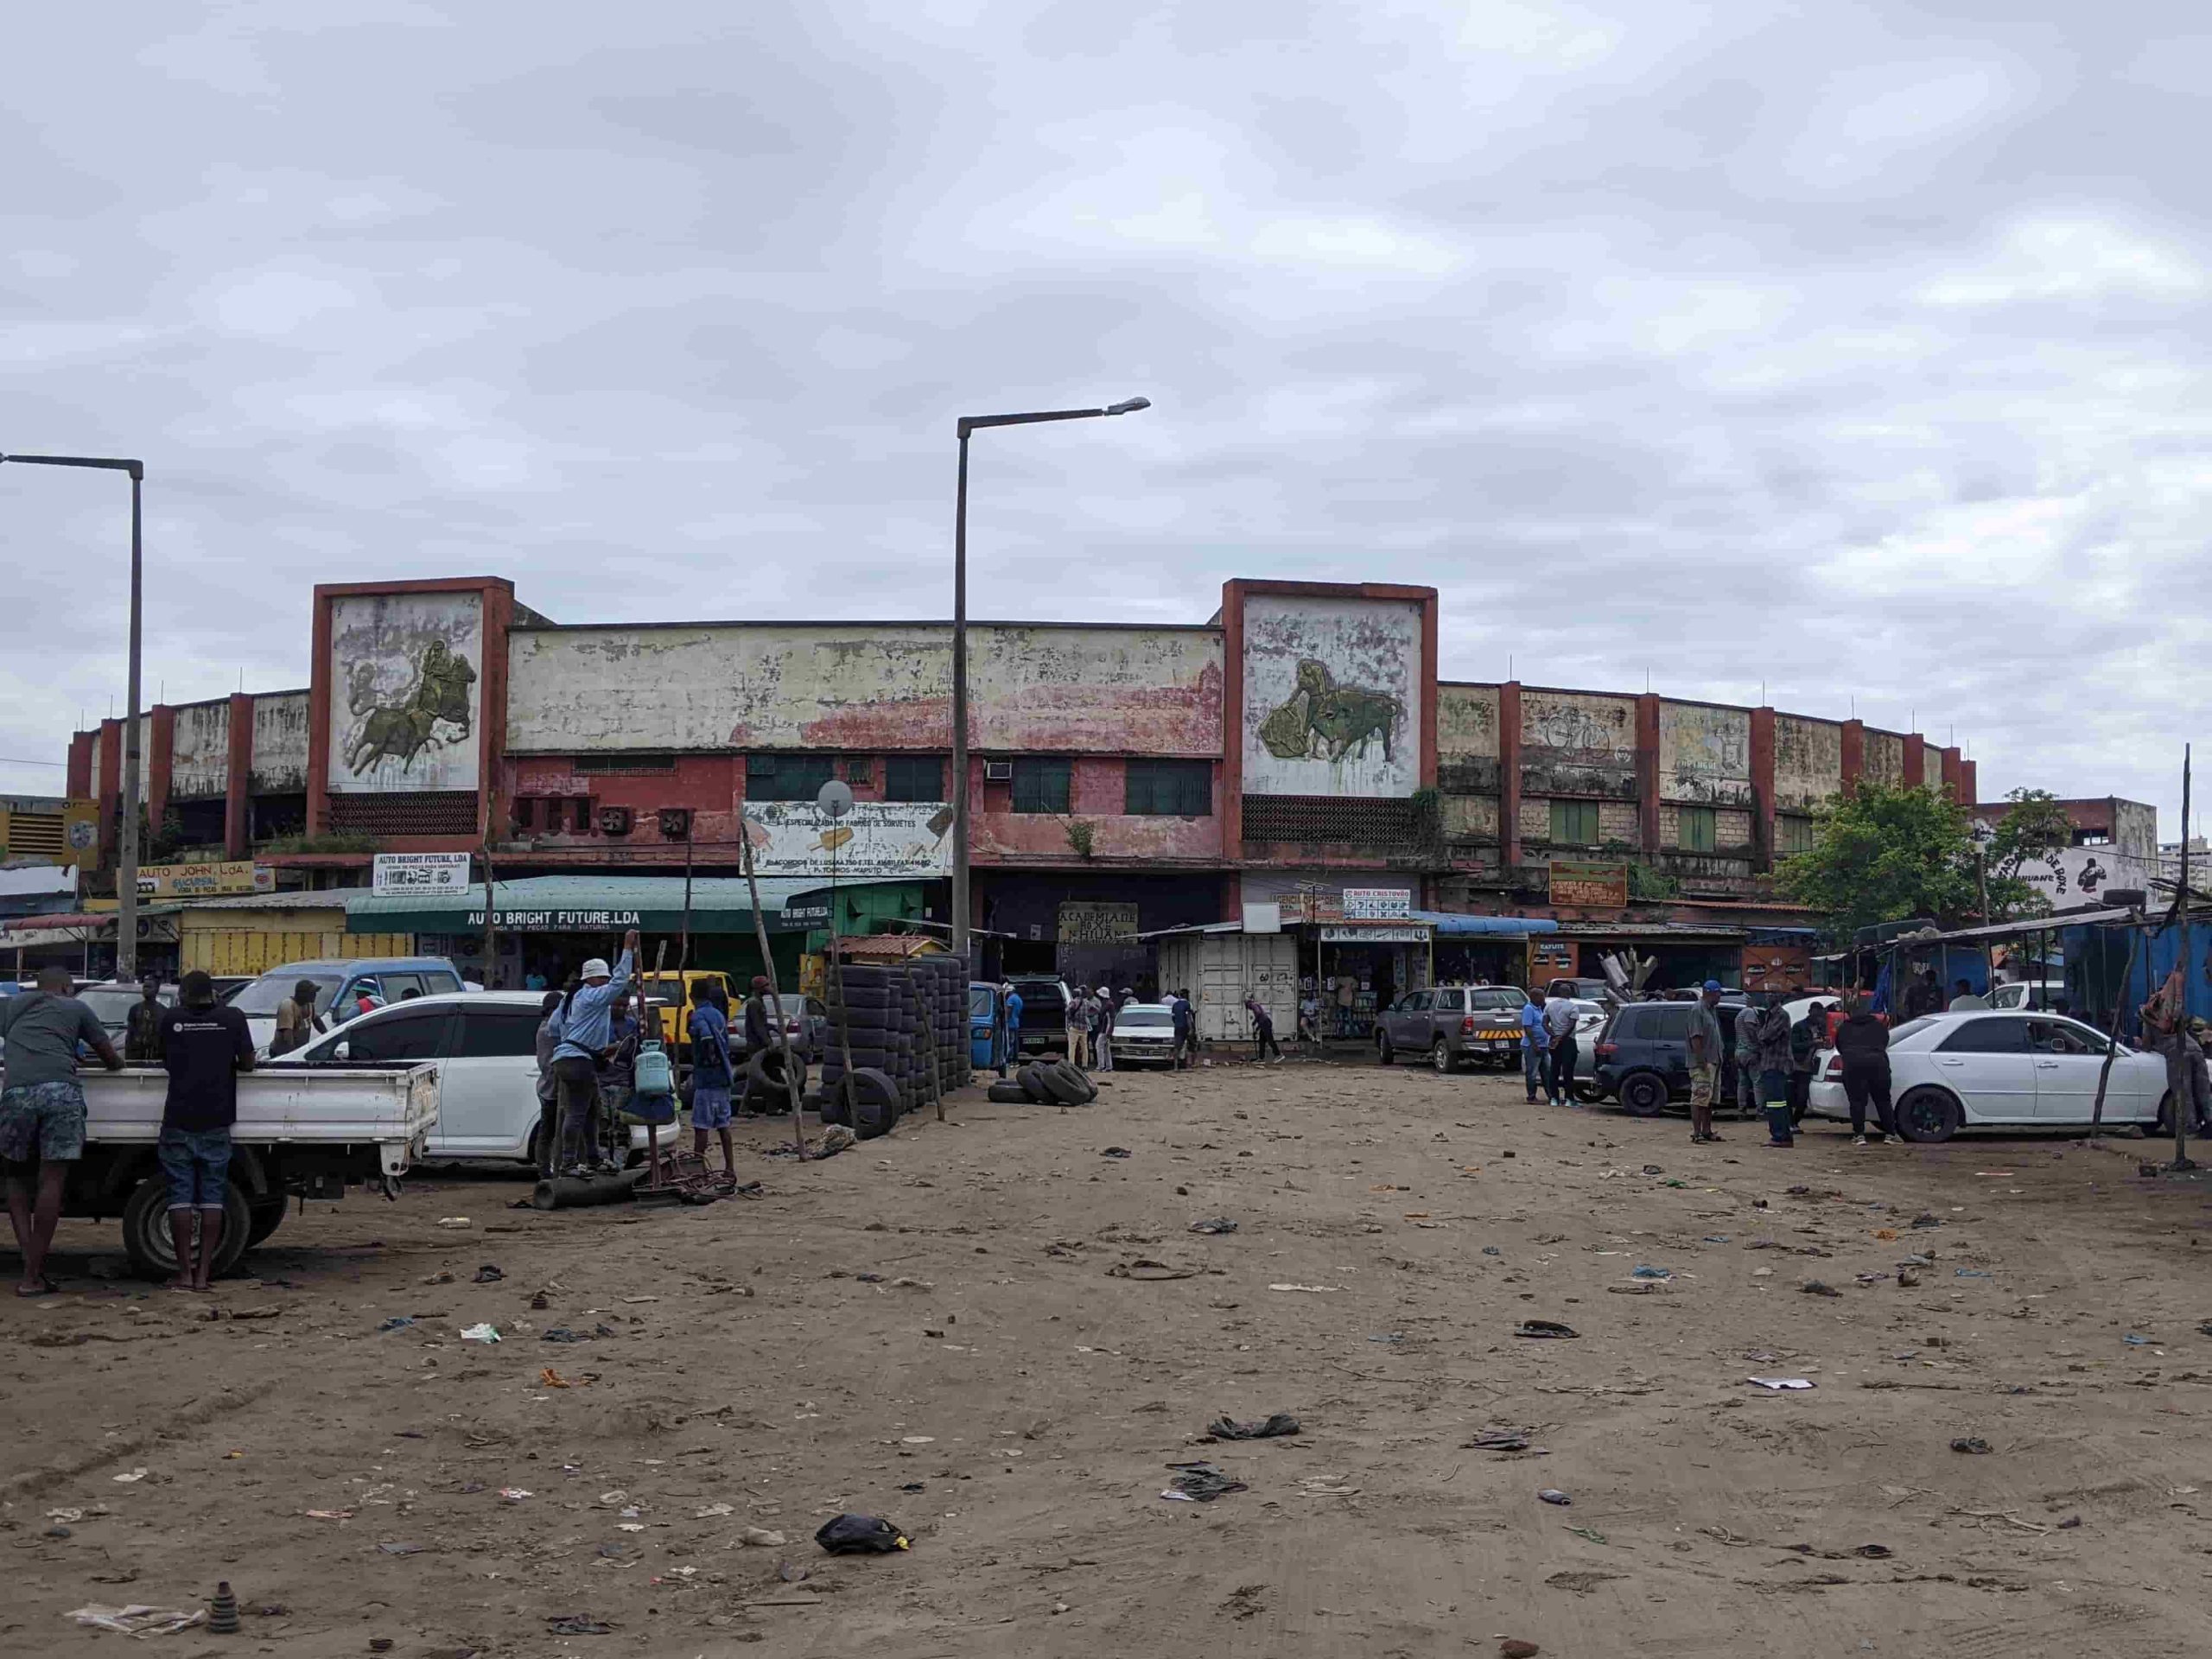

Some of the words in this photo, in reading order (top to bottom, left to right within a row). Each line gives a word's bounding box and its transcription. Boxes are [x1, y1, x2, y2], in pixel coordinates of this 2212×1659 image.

[379, 855, 396, 863] AUTO
[454, 854, 467, 862] LDA
[138, 867, 171, 879] AUTO
[2045, 854, 2060, 869] DE
[2053, 867, 2067, 895] BOXE
[467, 911, 501, 925] AUO
[506, 911, 551, 924] BRIGHT
